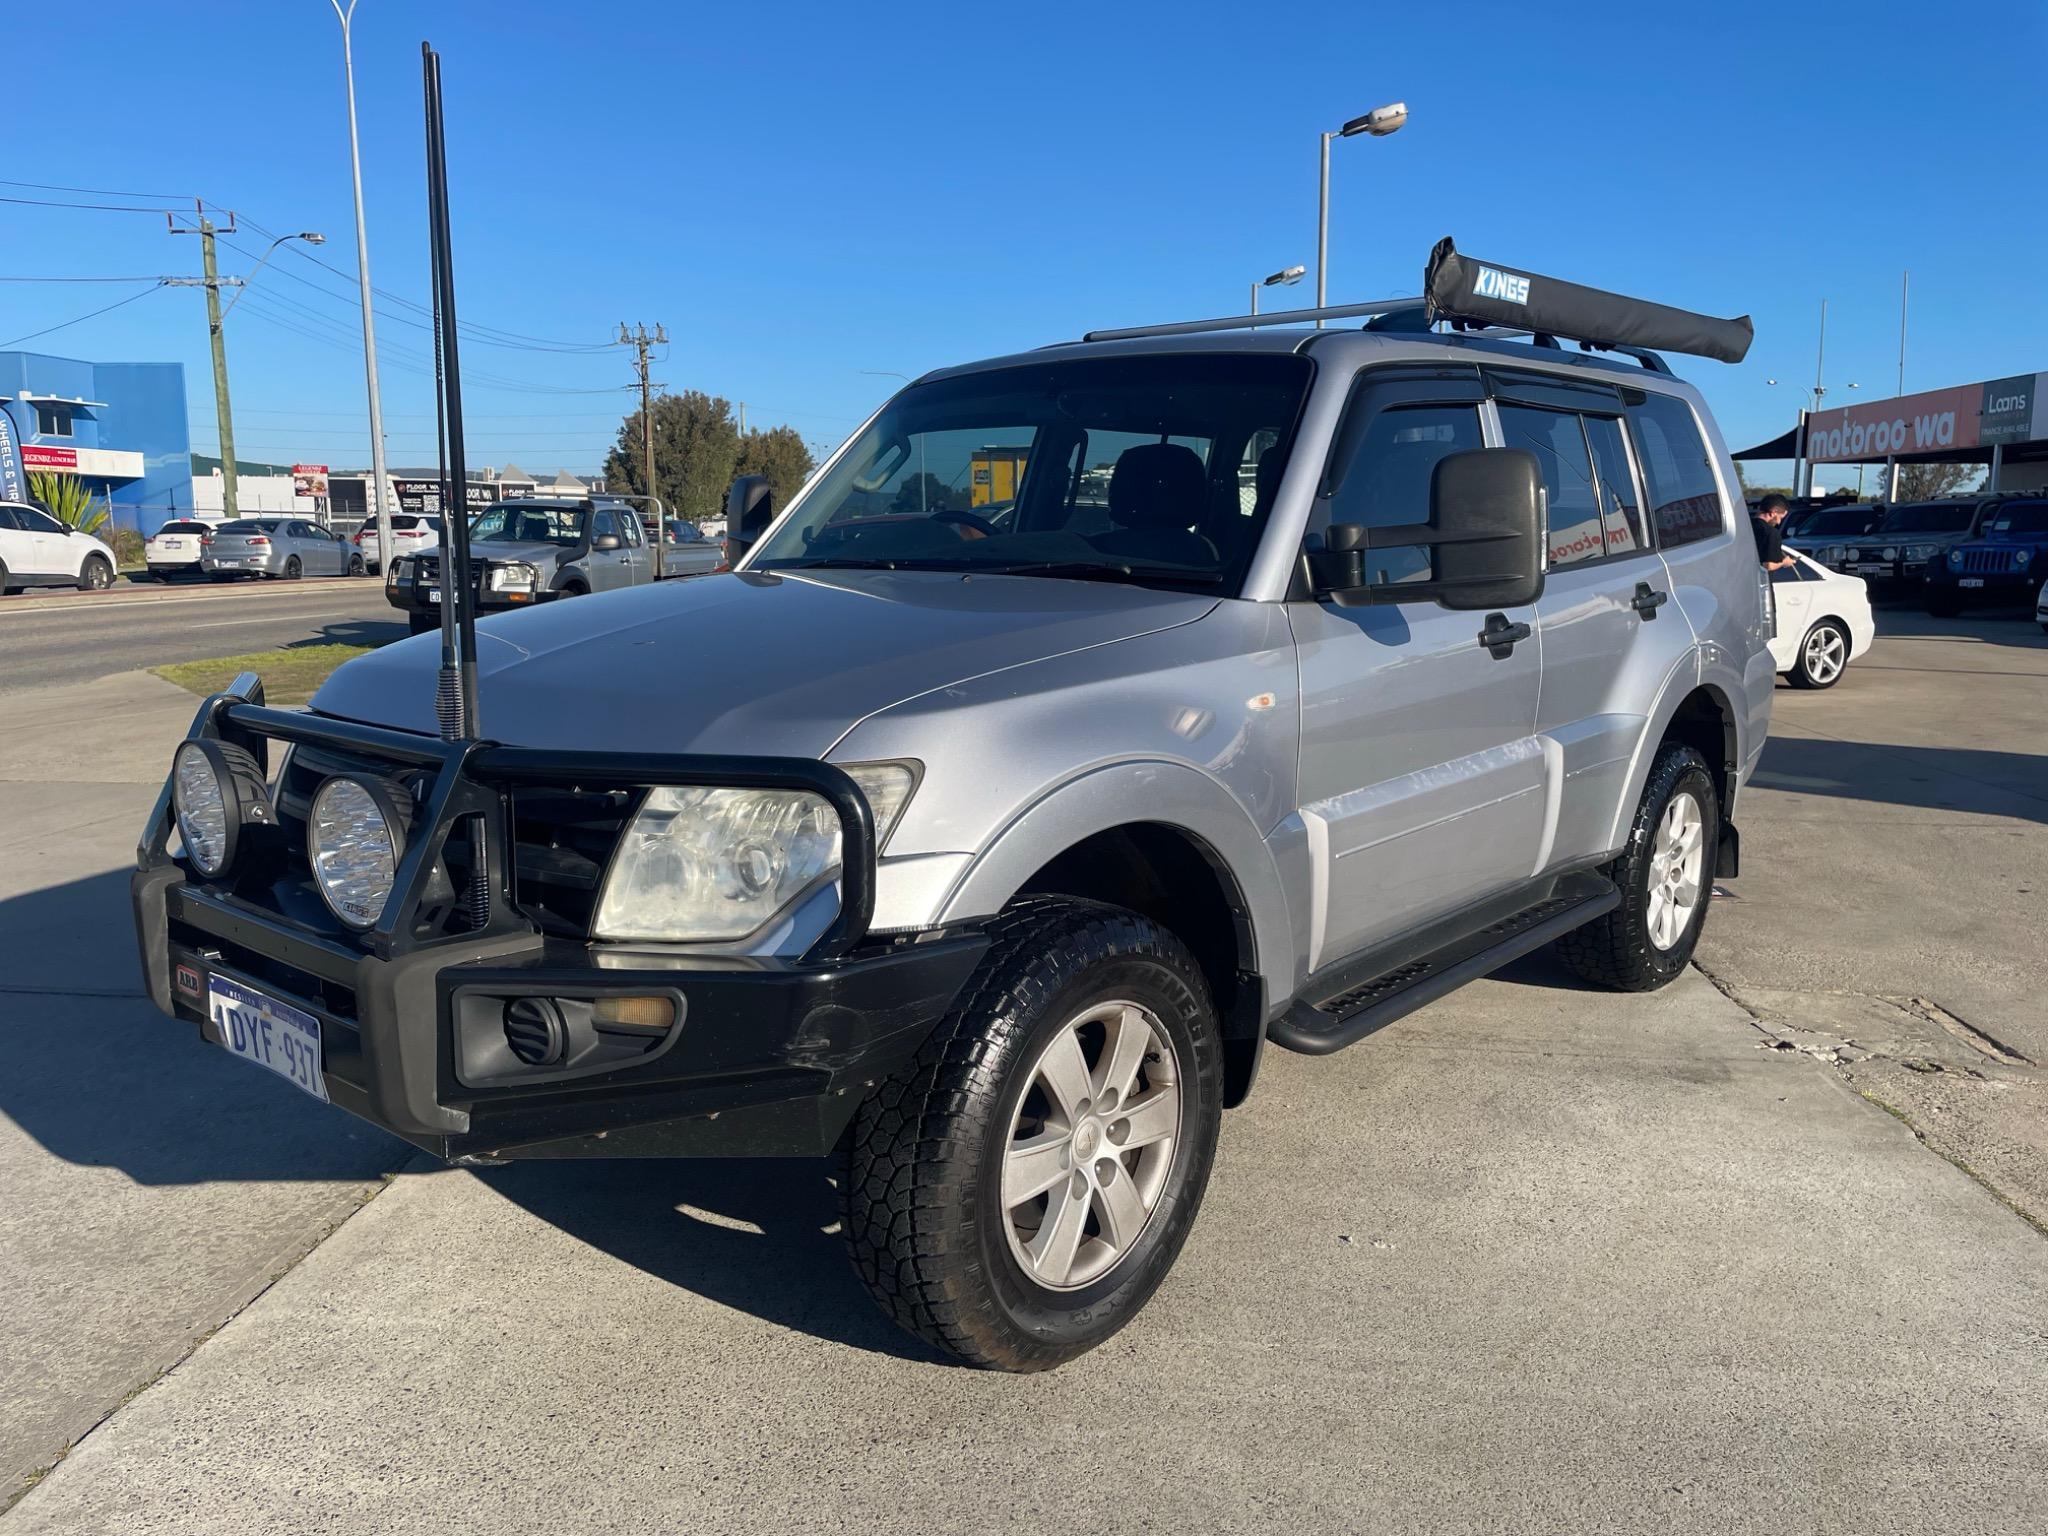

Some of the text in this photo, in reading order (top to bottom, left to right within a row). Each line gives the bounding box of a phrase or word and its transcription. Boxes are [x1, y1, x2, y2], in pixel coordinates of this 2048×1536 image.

[1473, 266, 1530, 305] KINGS
[1989, 394, 2026, 413] Loans
[1809, 410, 1955, 459] motoroo wa
[0, 420, 13, 467] WHEELS
[8, 482, 19, 502] TIR
[406, 483, 427, 491] FLOOR
[466, 487, 480, 499] OOR
[179, 970, 198, 992] ARB
